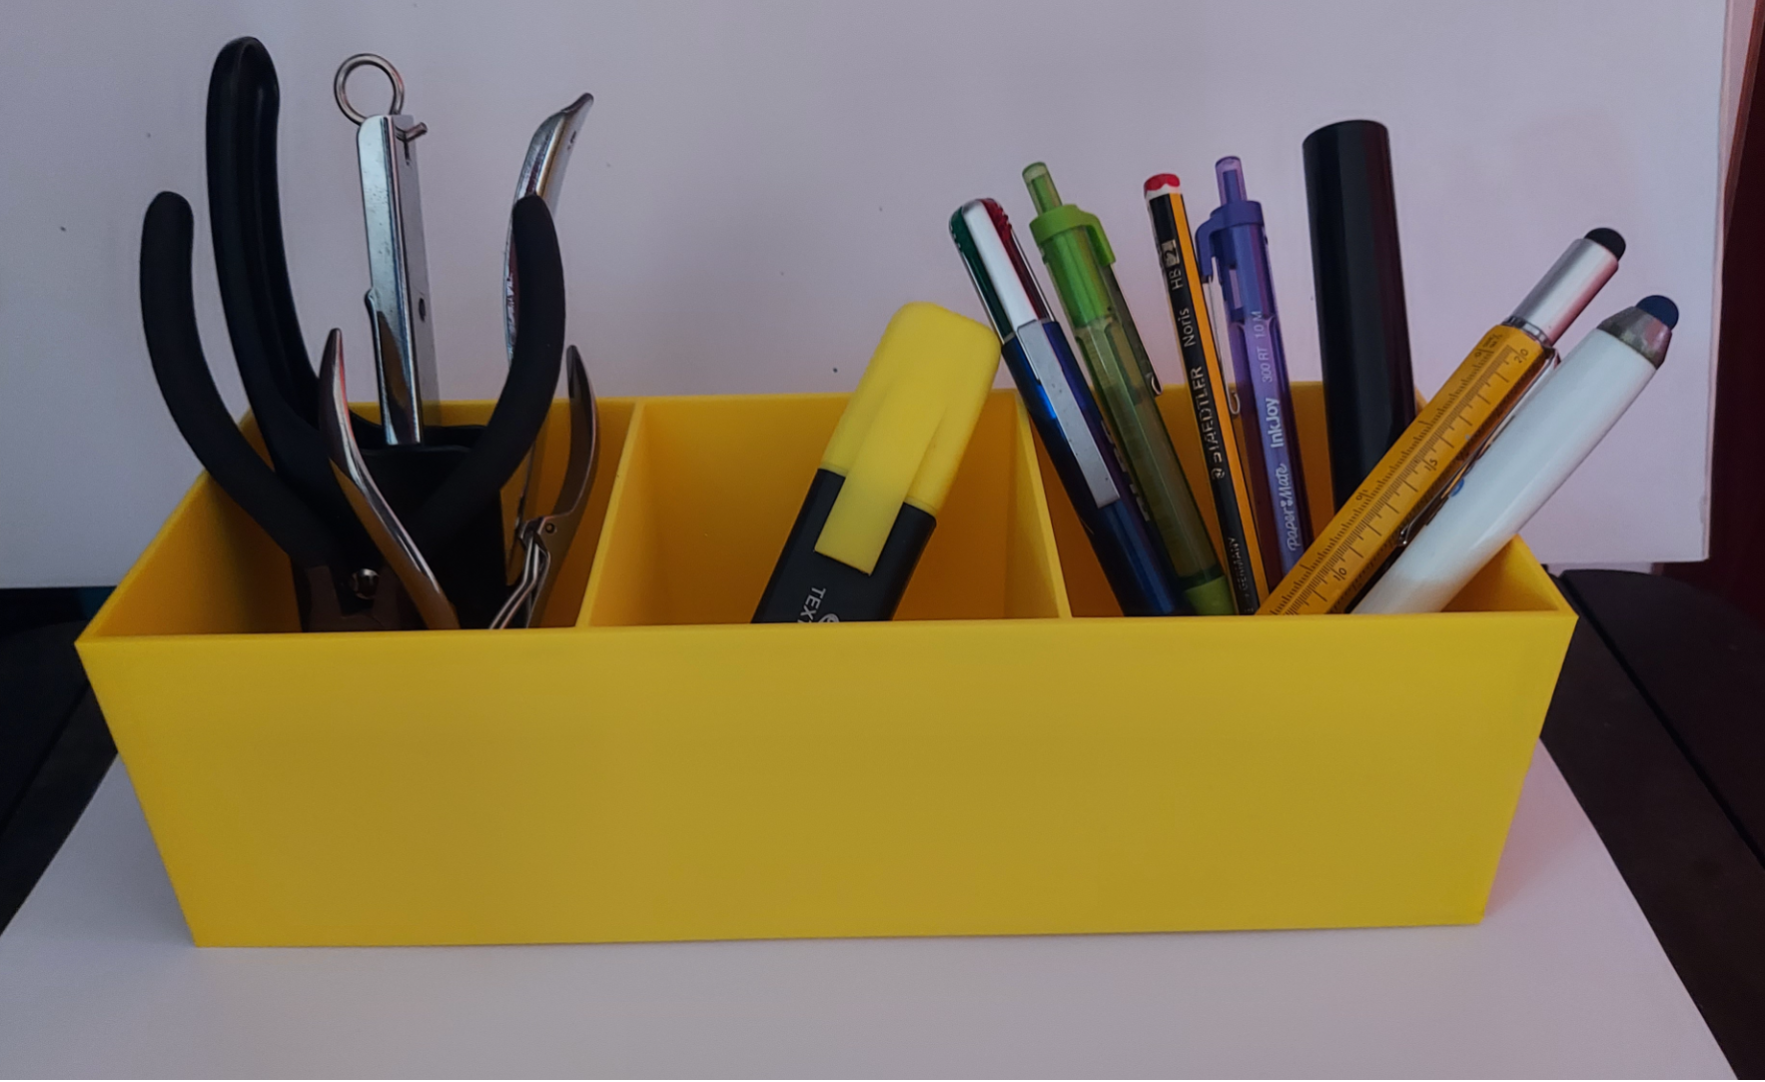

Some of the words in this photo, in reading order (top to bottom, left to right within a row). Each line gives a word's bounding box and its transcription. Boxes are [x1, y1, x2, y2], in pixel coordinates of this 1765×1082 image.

[1169, 268, 1184, 290] HB
[1178, 307, 1196, 347] Noris
[1256, 346, 1270, 361] RT
[1260, 362, 1273, 383] 300
[1265, 398, 1284, 448] InkJoy
